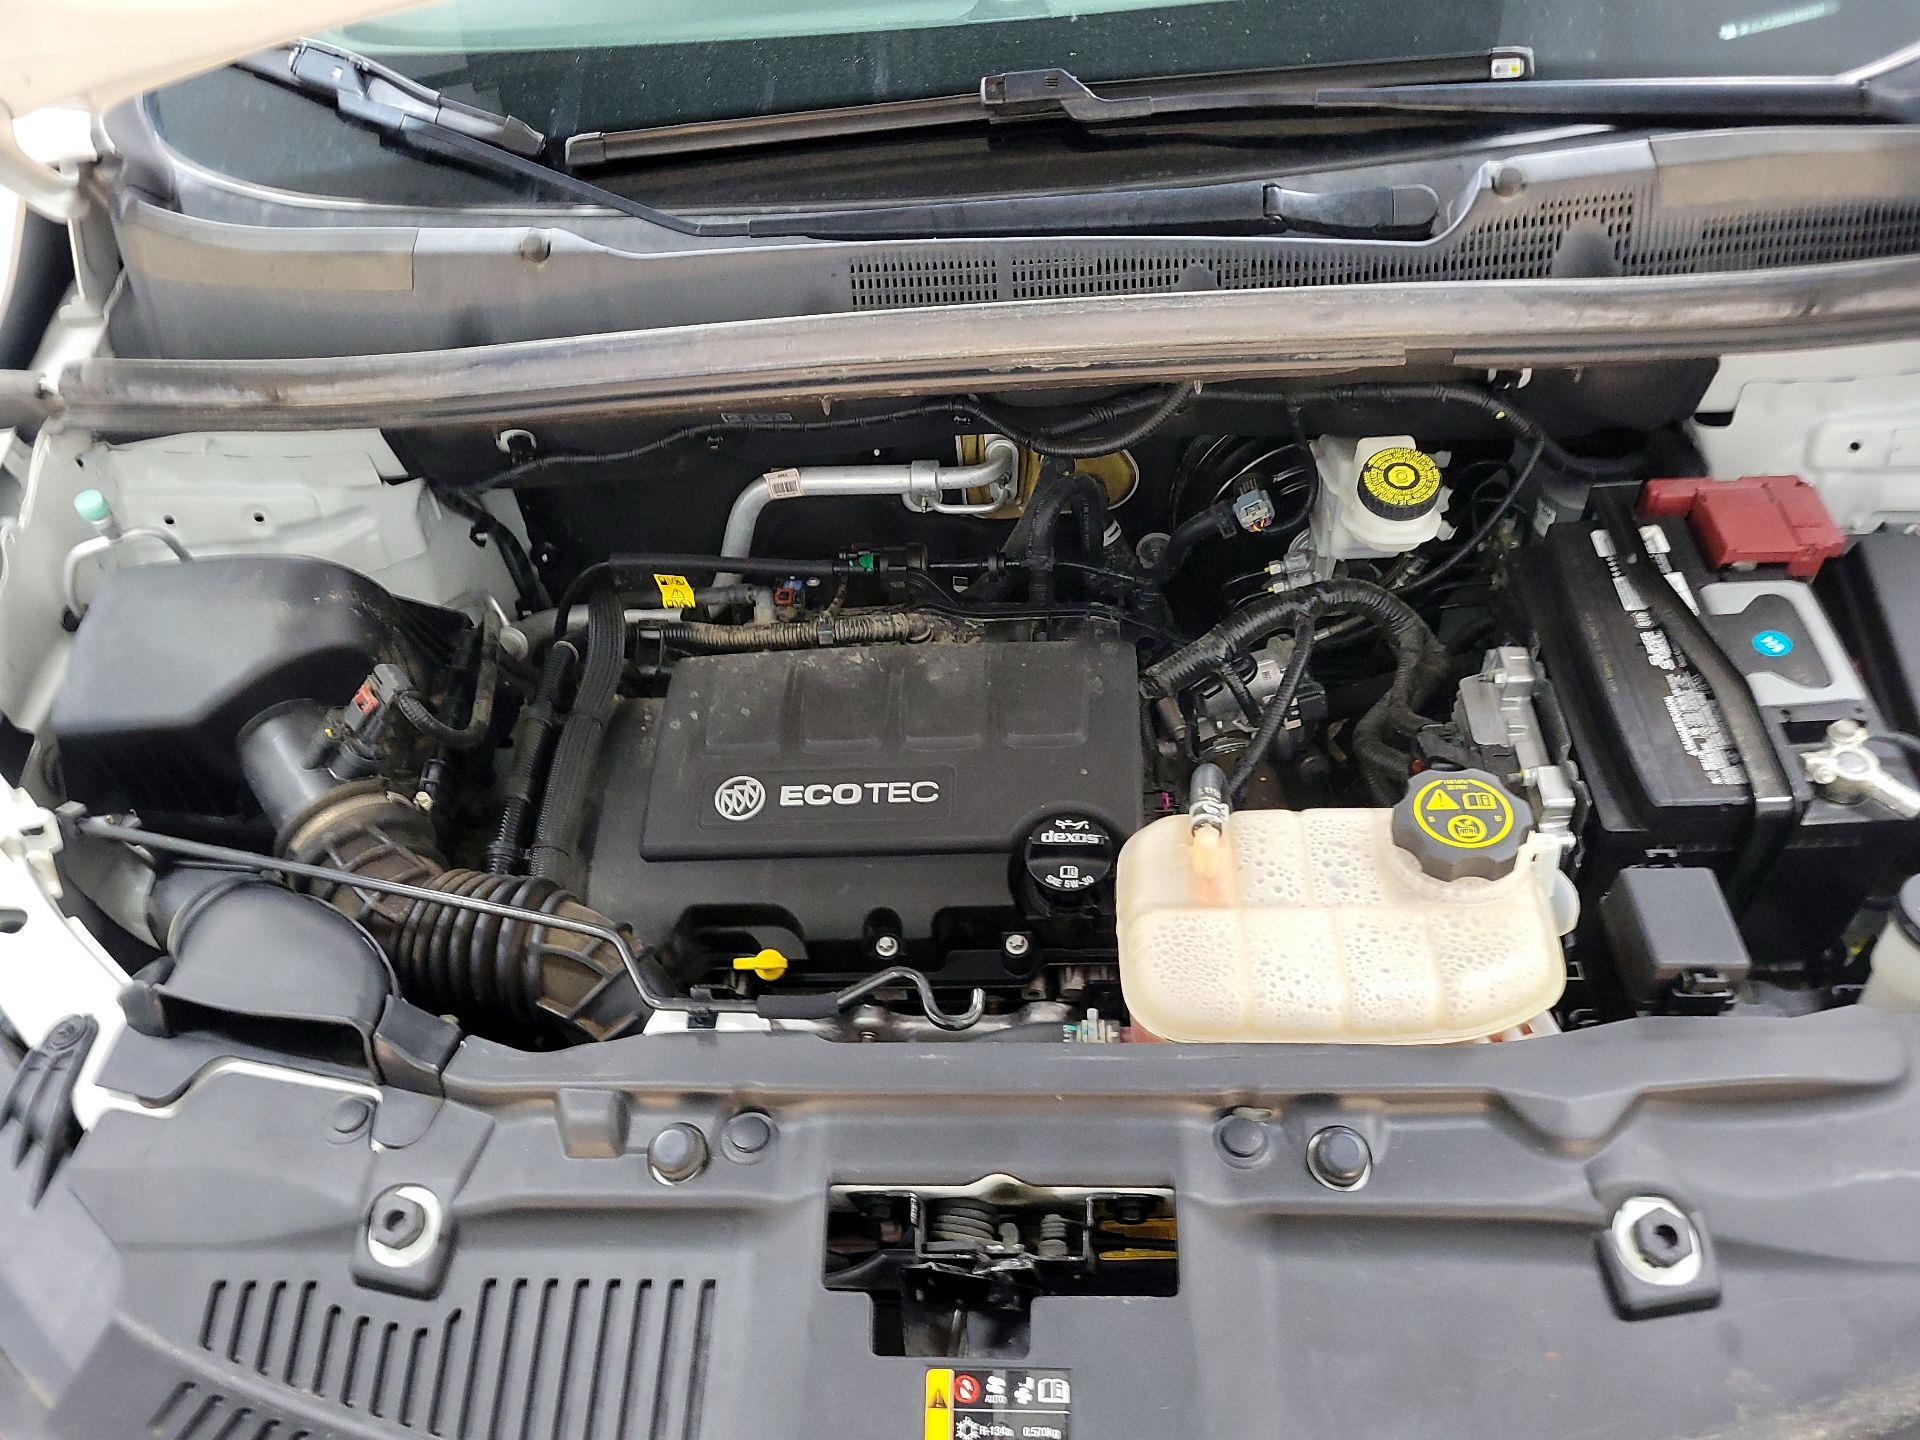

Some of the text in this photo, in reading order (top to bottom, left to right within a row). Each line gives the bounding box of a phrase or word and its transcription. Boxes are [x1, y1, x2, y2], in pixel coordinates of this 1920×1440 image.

[780, 781, 939, 806] ECOTEC
[1041, 830, 1100, 844] dexos
[1064, 875, 1095, 888] 5W-30
[984, 1394, 1006, 1404] AUTO
[1022, 1426, 1062, 1439] 0.570kg
